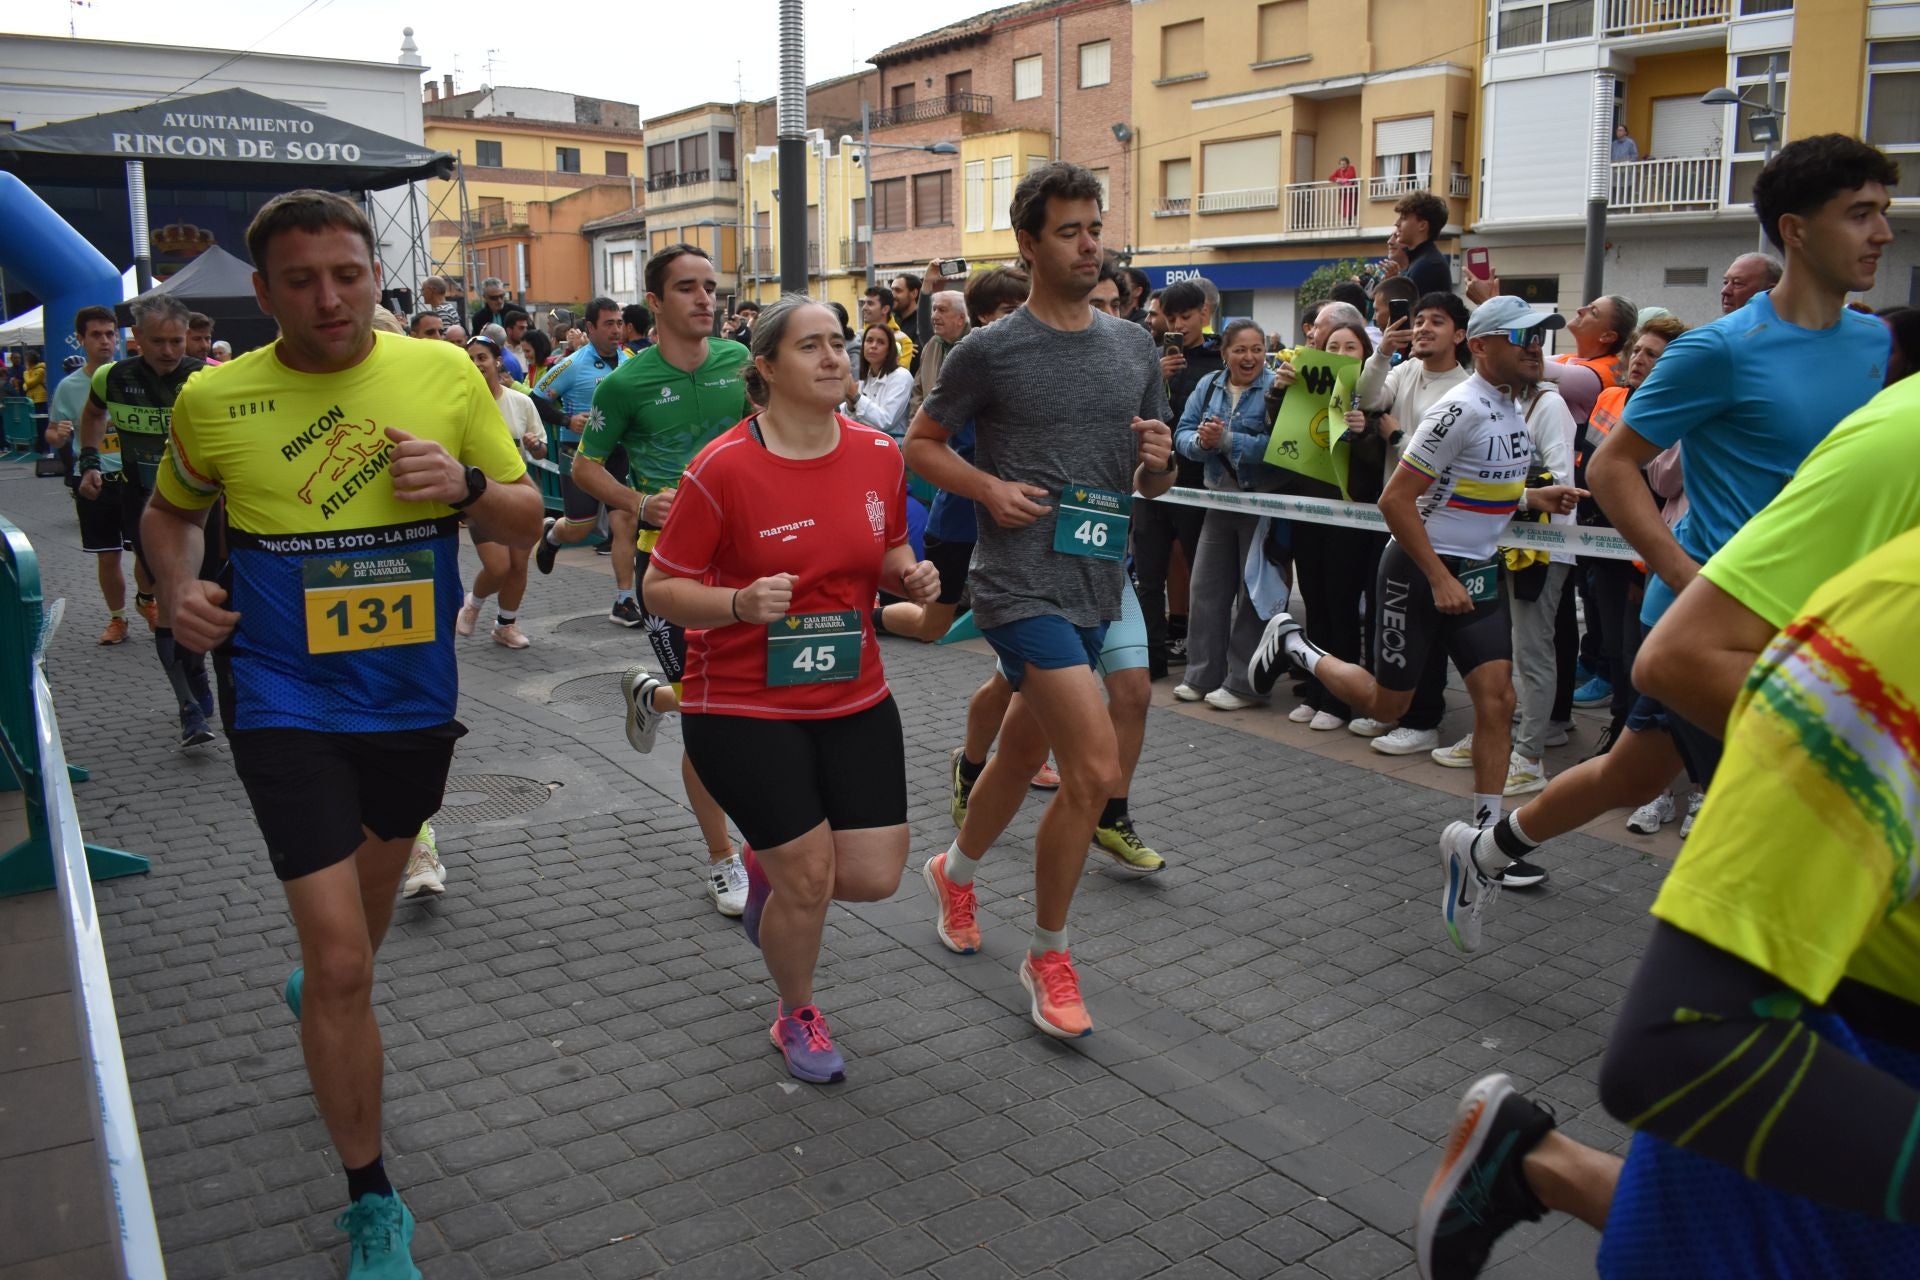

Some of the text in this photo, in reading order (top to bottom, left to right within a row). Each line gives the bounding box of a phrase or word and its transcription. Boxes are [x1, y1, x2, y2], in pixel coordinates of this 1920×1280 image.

[163, 112, 314, 134] AYUNTAMIENTO
[112, 132, 361, 162] RINCON DE SOTO
[1165, 267, 1201, 285] BBVA
[229, 400, 276, 419] GOBIK
[655, 394, 680, 405] VIATOR
[116, 411, 140, 425] LA
[1422, 404, 1463, 455] INEOS
[280, 404, 346, 462] RINCON
[1485, 430, 1531, 462] INEO
[315, 538, 336, 551] DE
[339, 534, 375, 548] SOTO
[384, 530, 403, 543] LA
[405, 524, 438, 539] RIOJA
[760, 518, 815, 538] marmarra
[1074, 520, 1108, 547] 46
[353, 559, 407, 570] CAJA RURAL
[354, 566, 411, 577] DE NAVARRA
[1466, 576, 1484, 596] 28
[326, 594, 413, 637] 131
[815, 621, 846, 629] NAVARRA
[1382, 578, 1410, 669] INEOS
[660, 630, 681, 672] Ramiro
[793, 645, 836, 672] 45
